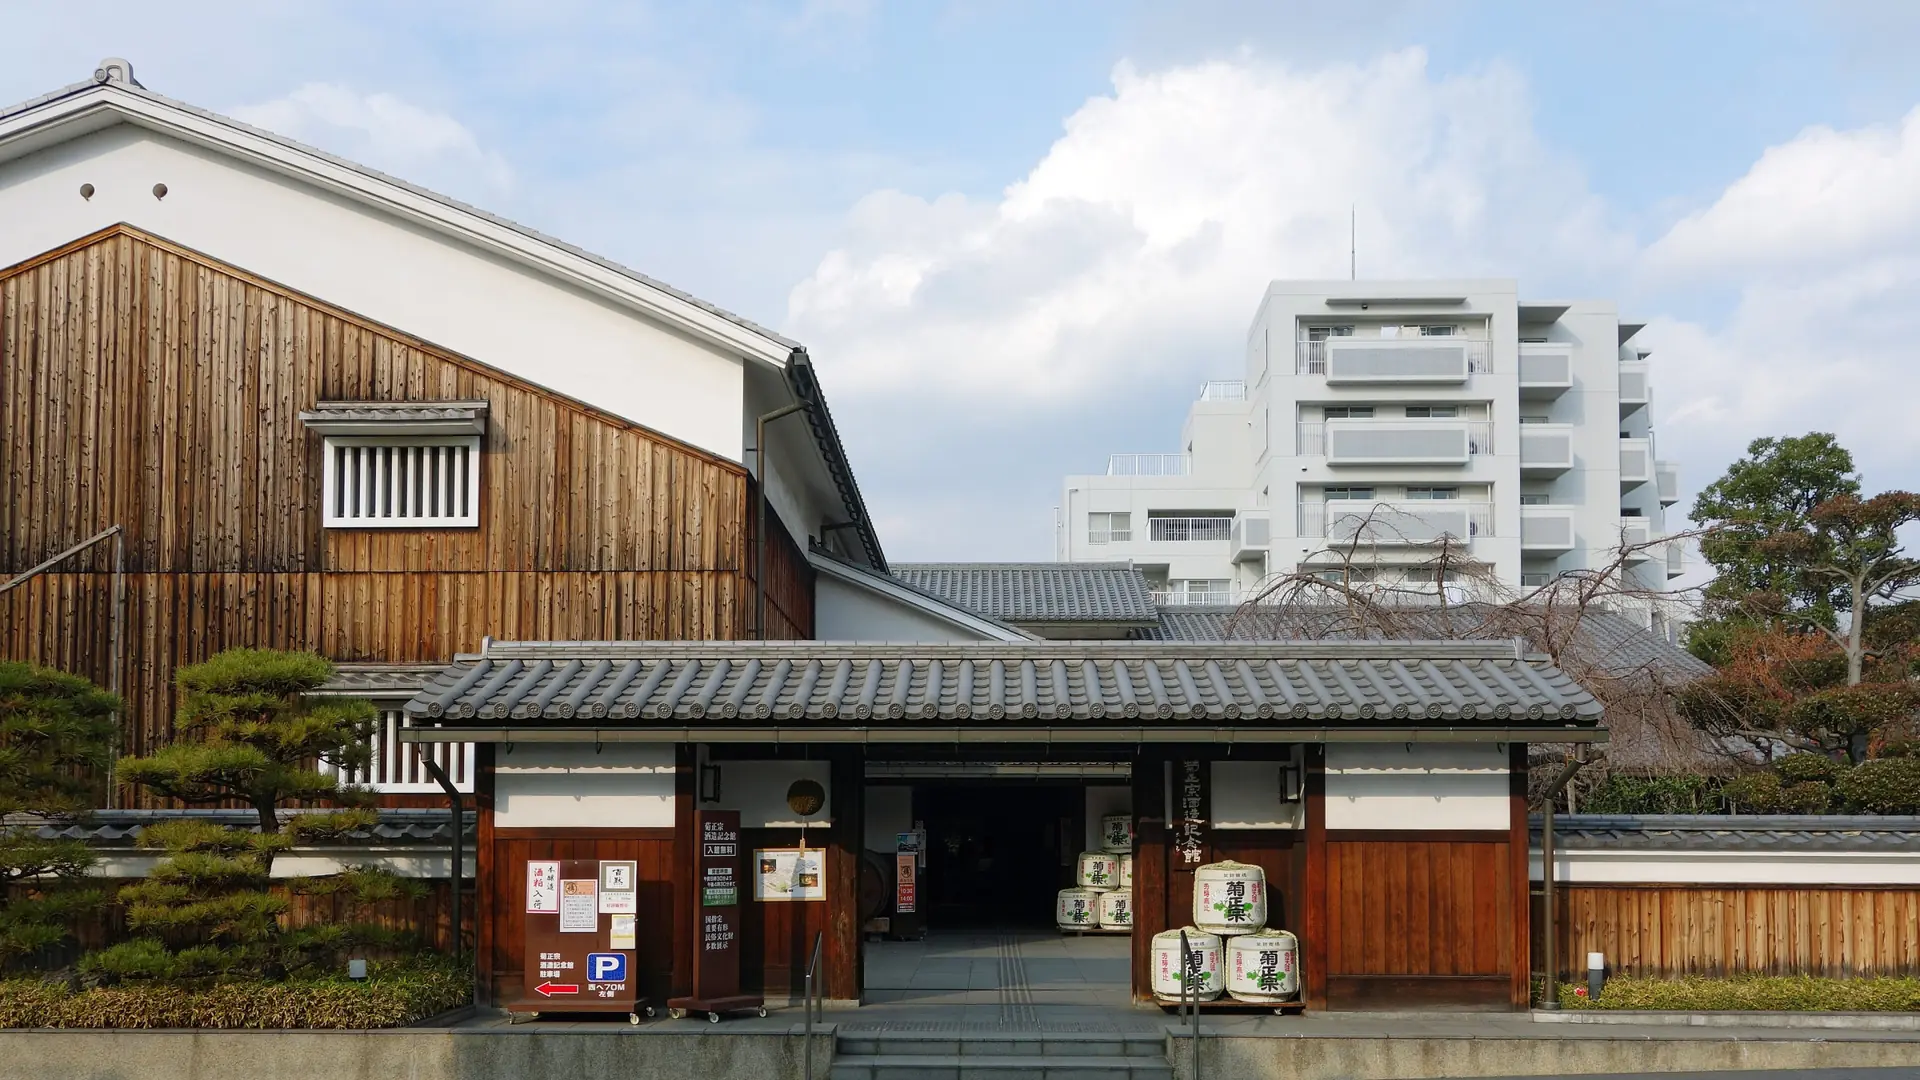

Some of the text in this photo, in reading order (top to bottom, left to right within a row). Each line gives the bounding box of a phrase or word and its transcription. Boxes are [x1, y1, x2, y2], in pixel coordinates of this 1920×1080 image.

[704, 822, 724, 831] 菊正宗
[1182, 760, 1205, 863] 菊正宗酒造記念館
[704, 832, 736, 841] 酒造記念館
[1226, 881, 1246, 923] 菊正宗
[595, 957, 619, 979] P
[1259, 950, 1279, 992] 菊正宗
